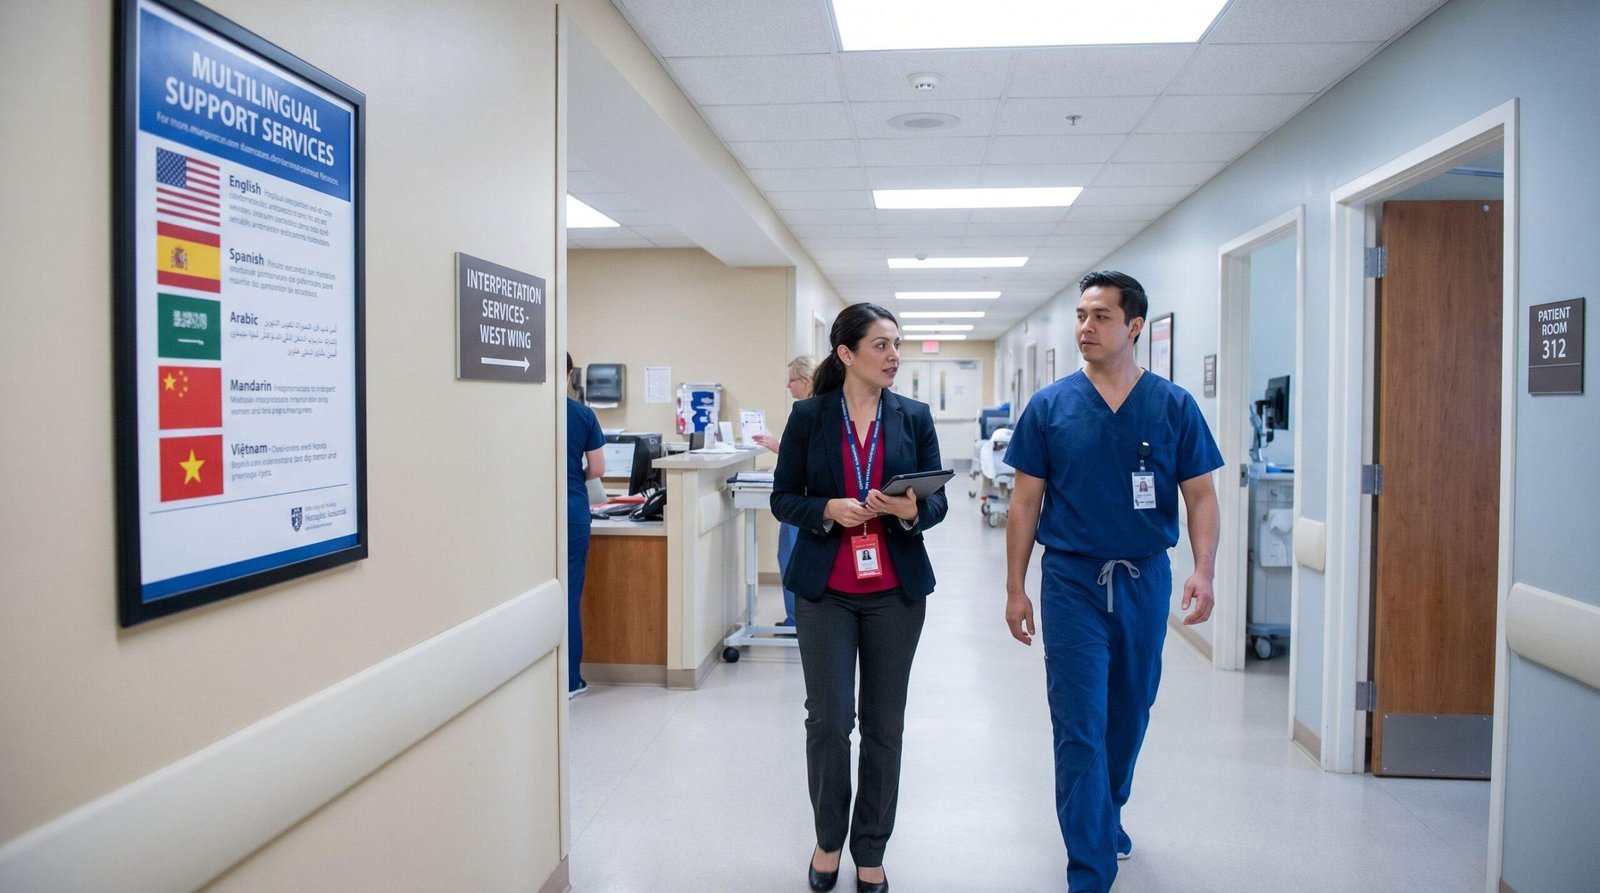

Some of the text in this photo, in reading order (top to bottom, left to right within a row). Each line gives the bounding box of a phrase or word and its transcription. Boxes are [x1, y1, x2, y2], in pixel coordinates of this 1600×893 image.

[192, 51, 321, 133] MULTILINGUAL
[165, 76, 258, 136] SUPPORT
[262, 117, 335, 167] SERVICES
[229, 175, 262, 195] English
[229, 248, 264, 266] Spanish
[467, 268, 542, 305] INTERPRETATION
[230, 311, 258, 326] Arabic
[482, 299, 525, 325] SERVICES
[1538, 306, 1571, 322] PATIENT
[479, 324, 531, 350] WEST WING
[1541, 321, 1568, 336] ROOM
[1542, 338, 1567, 359] 312
[230, 379, 272, 392] Mandarin
[231, 443, 268, 459] Việtnam
